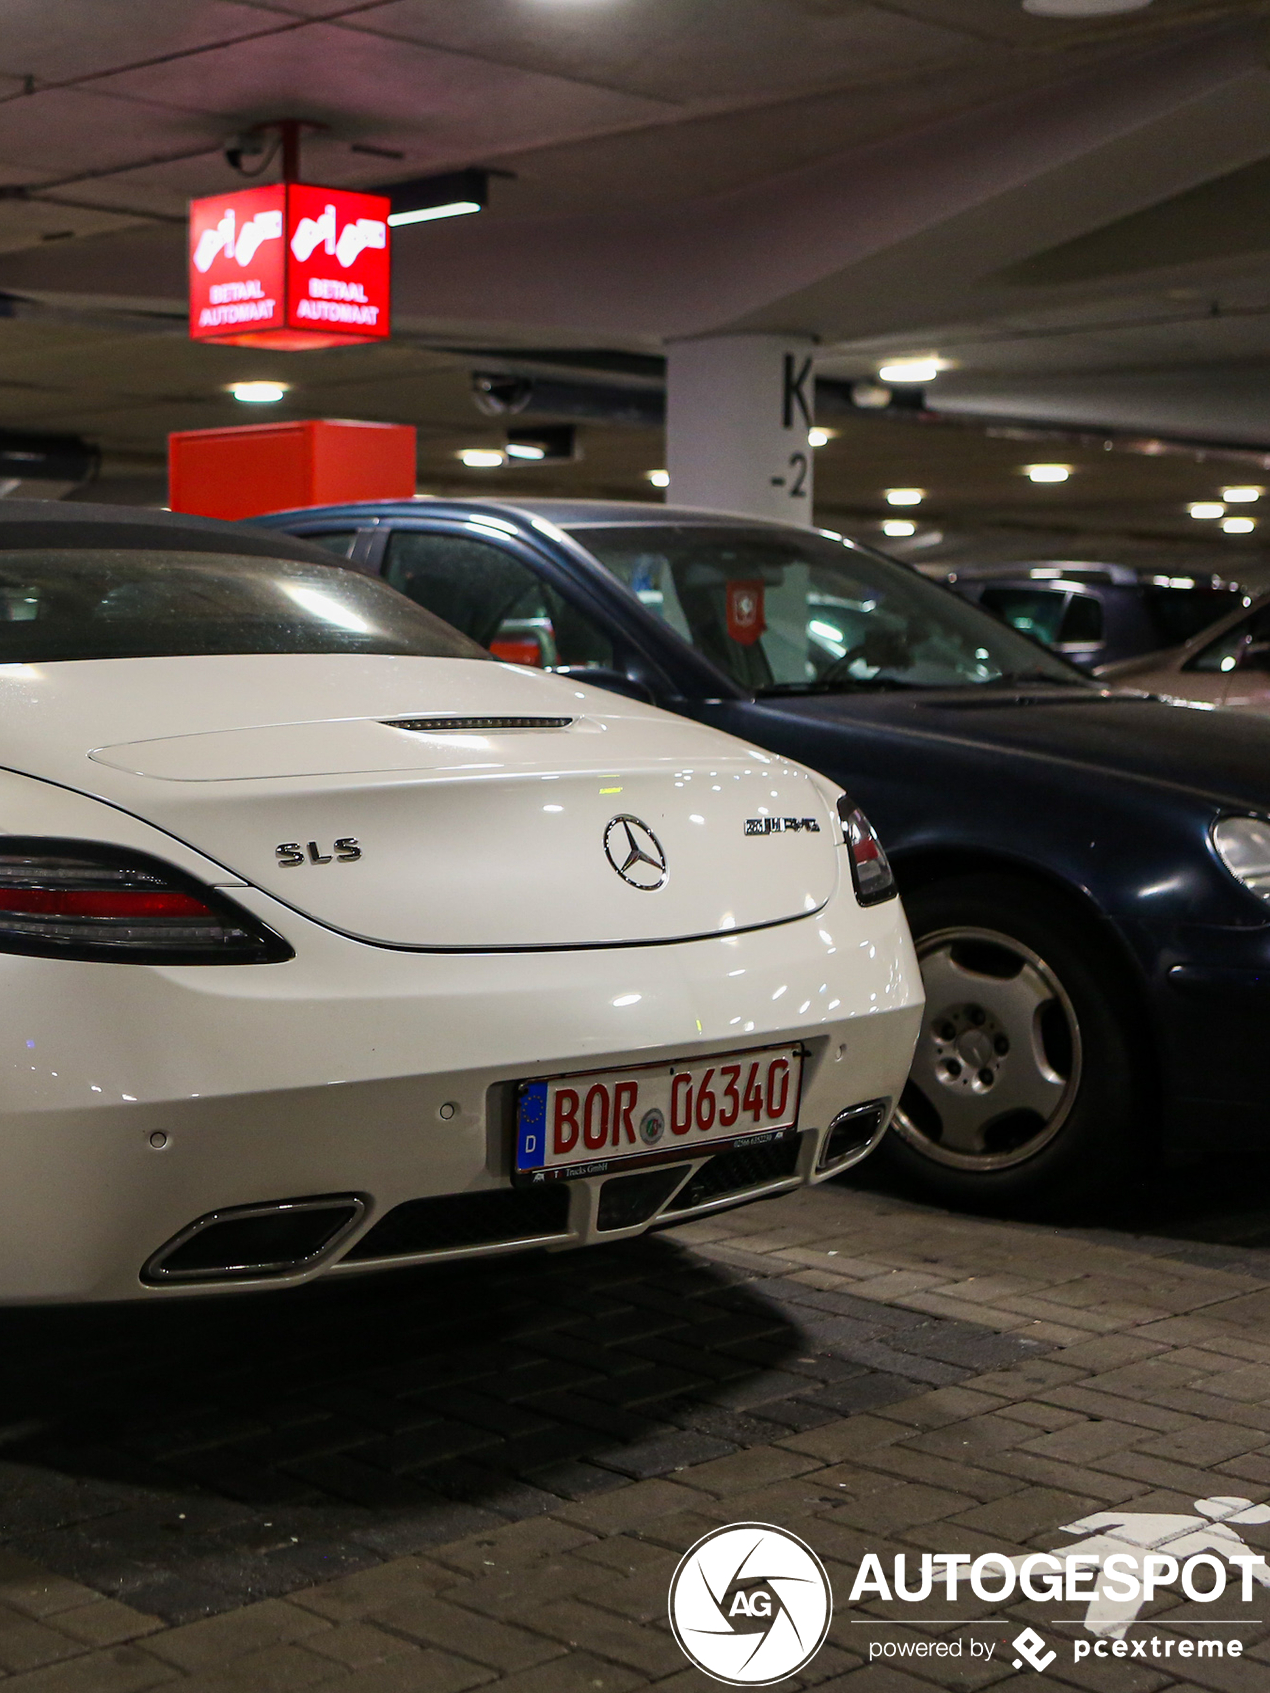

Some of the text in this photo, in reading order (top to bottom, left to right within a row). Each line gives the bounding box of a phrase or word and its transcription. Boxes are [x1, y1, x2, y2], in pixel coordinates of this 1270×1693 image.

[210, 280, 264, 303] BETAAL
[309, 278, 368, 303] BETAAL
[199, 300, 275, 326] AUTOMAAT
[297, 300, 379, 325] AUTOMAAT
[784, 353, 812, 429] K
[771, 453, 806, 497] -2
[276, 837, 362, 867] SLS
[554, 1080, 638, 1154] BOR
[671, 1058, 789, 1135] 06340
[525, 1135, 536, 1153] D
